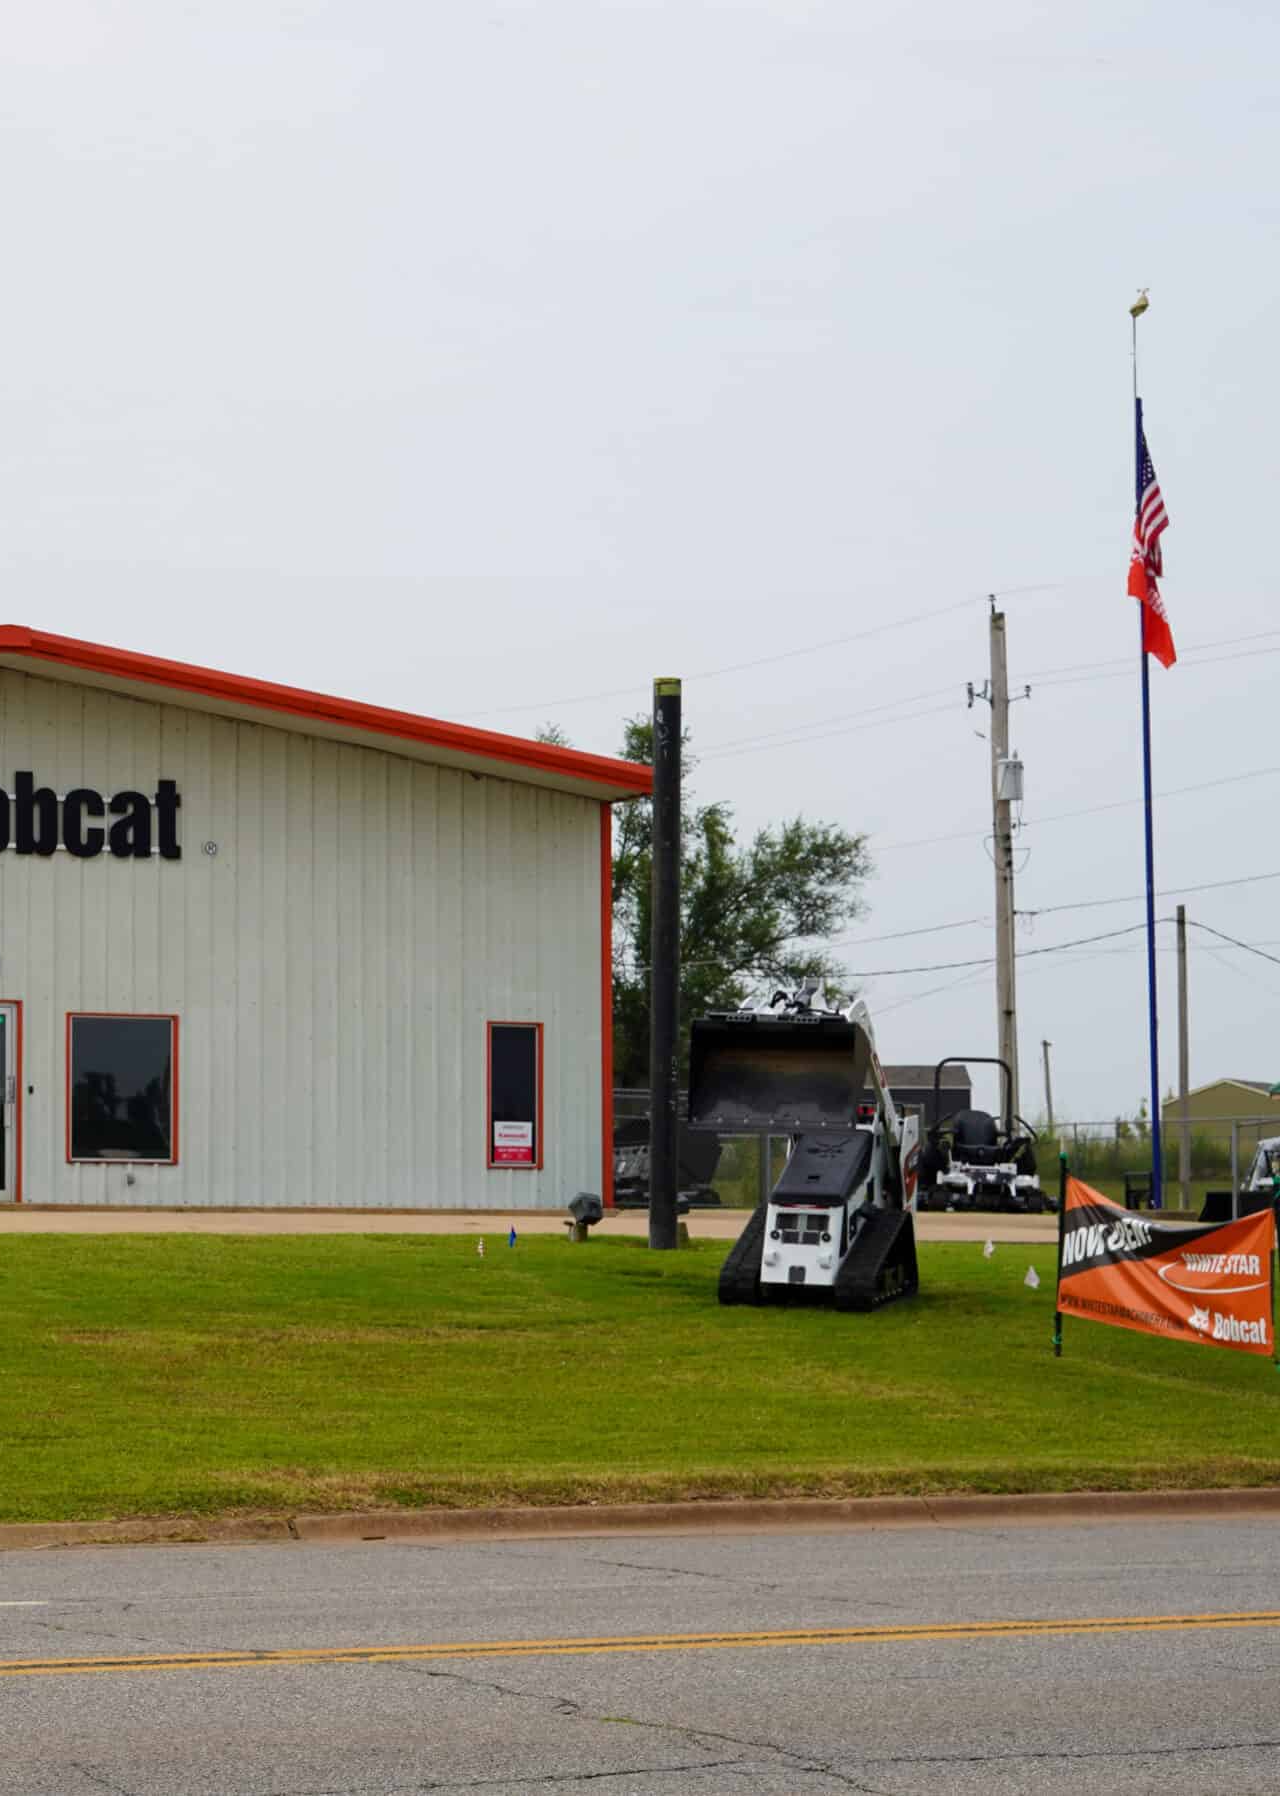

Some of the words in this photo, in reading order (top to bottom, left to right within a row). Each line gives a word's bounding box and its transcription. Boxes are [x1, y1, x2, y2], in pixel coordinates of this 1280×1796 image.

[1062, 1224, 1108, 1267] NOW
[1223, 1253, 1260, 1276] STAR
[1212, 1311, 1267, 1345] Bobcat
